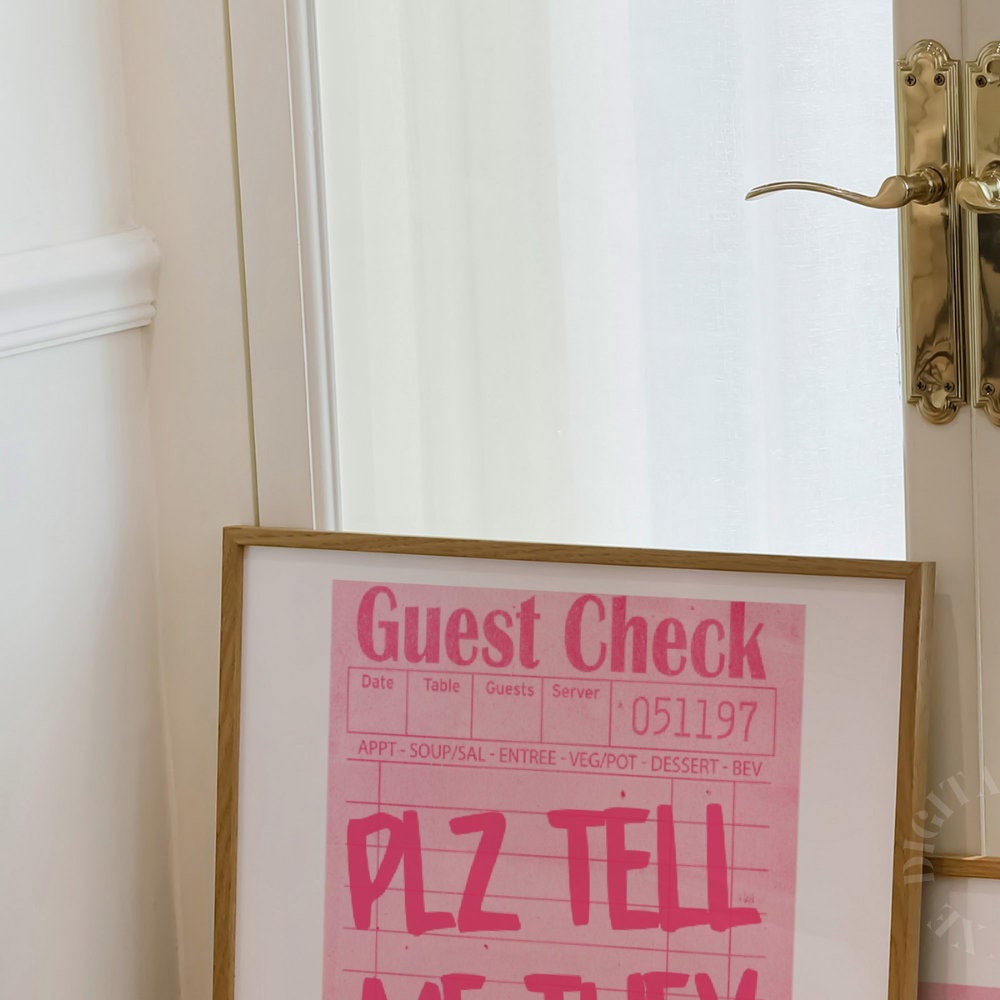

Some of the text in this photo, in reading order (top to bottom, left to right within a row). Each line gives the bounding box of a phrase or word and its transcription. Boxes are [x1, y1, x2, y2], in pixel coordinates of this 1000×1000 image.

[357, 586, 766, 680] Guest Check
[361, 674, 759, 742] Date Table Guests Server 051197
[358, 739, 396, 758] APPT
[409, 743, 486, 762] SOUP/SAL
[499, 748, 557, 767] ENTREE
[569, 752, 637, 771] VEG/POT
[651, 756, 719, 775] DESSERT
[733, 760, 763, 777] BEV
[347, 803, 762, 936] PLZ TELL
